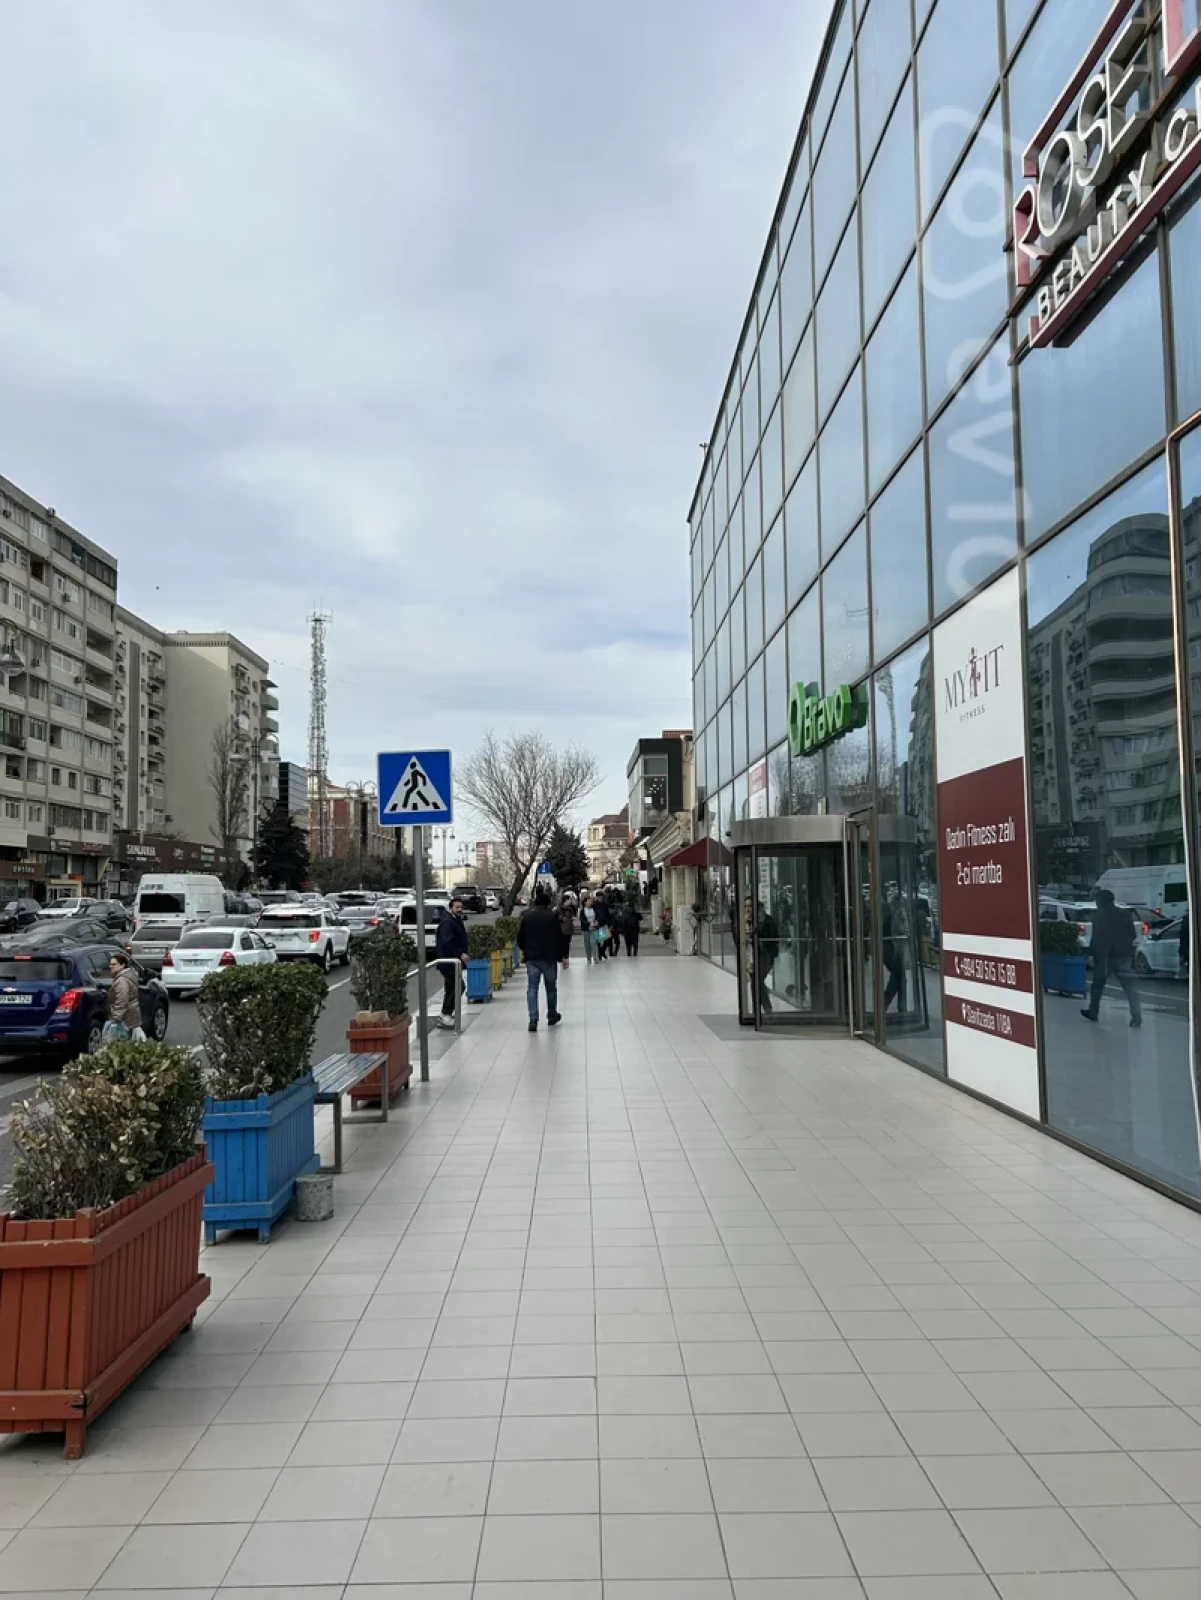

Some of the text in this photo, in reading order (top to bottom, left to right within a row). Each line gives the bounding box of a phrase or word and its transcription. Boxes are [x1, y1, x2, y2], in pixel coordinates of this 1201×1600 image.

[1013, 17, 1149, 286] ROSE
[1038, 151, 1149, 328] BEAUTY
[803, 683, 848, 745] Bravo
[959, 704, 985, 724] FITNESS
[966, 823, 997, 847] Fitness
[956, 861, 971, 885] 2-ci
[975, 959, 984, 979] 50
[997, 963, 1006, 983] 15
